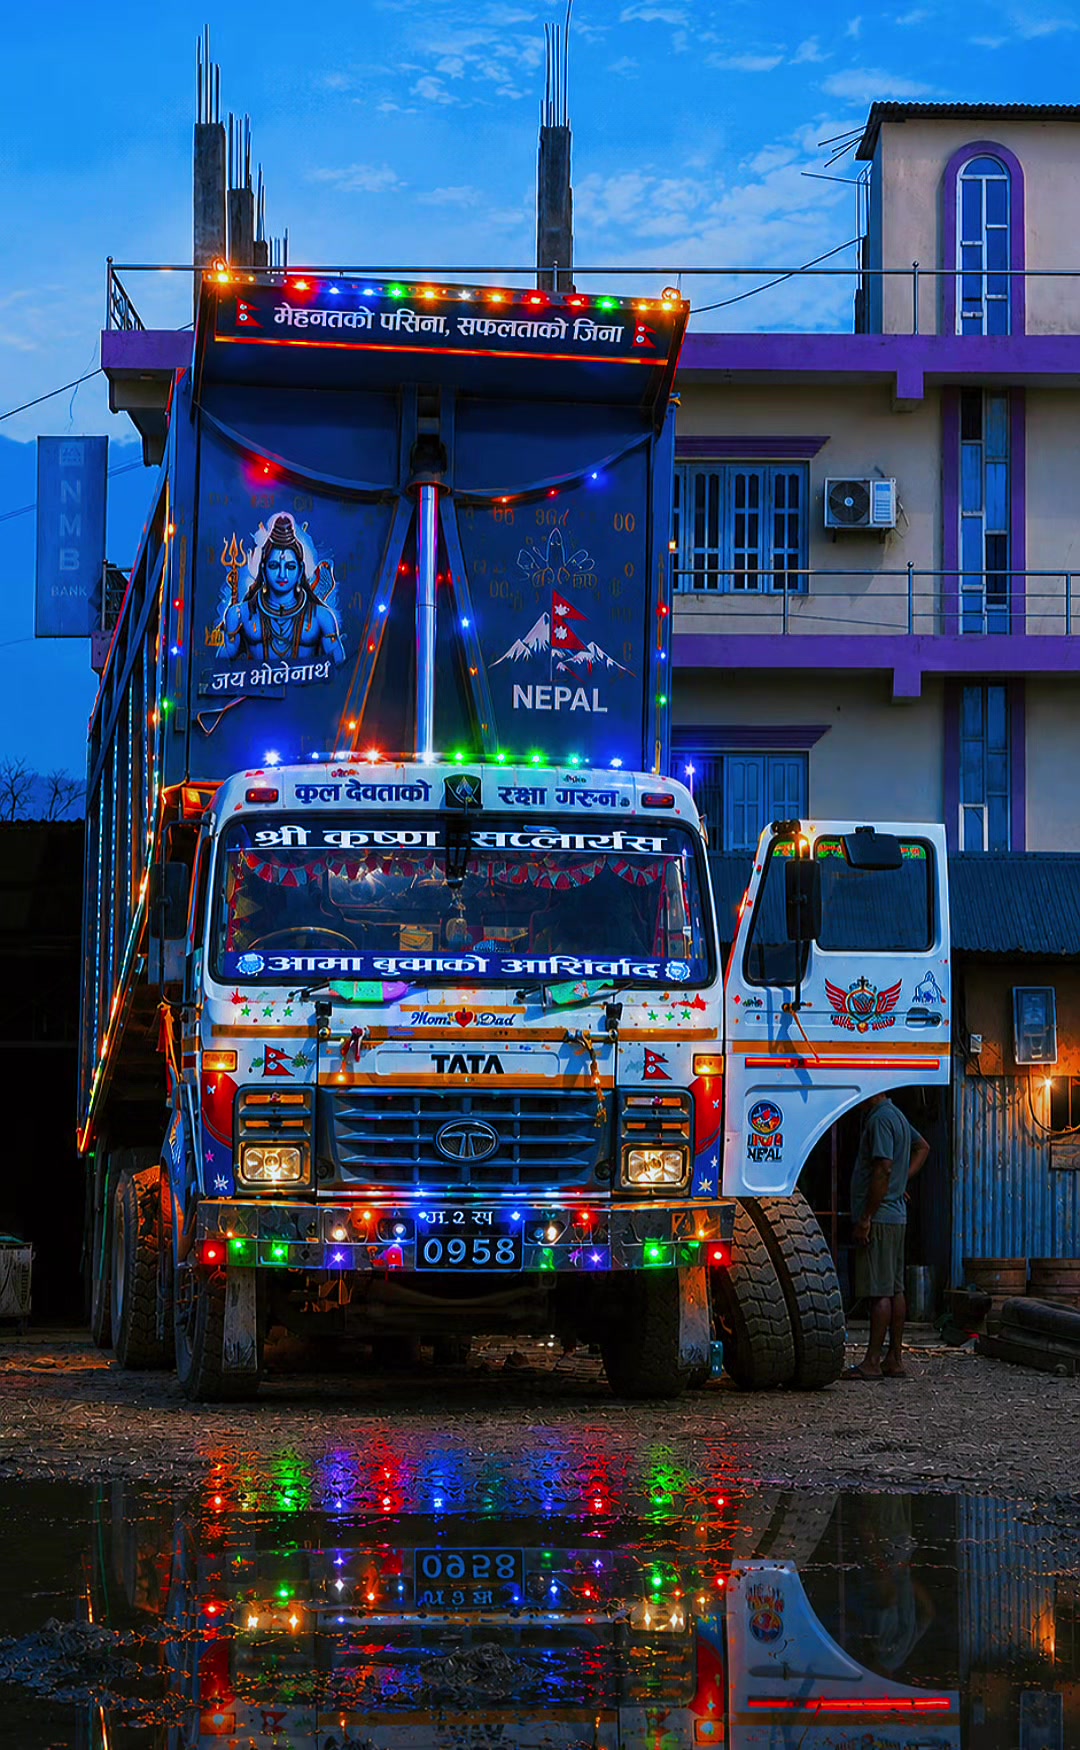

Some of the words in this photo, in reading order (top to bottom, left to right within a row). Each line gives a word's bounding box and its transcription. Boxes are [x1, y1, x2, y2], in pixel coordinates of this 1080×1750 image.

[274, 302, 375, 329] मेहनतको
[380, 309, 450, 337] पसिना,
[456, 317, 569, 340] सफलताको
[573, 317, 625, 343] जिना
[51, 585, 88, 597] BANK
[211, 671, 246, 691] जय
[250, 660, 331, 686] भोलेनाथ
[512, 683, 608, 714] NEPAL
[295, 783, 342, 804] कुल
[345, 778, 432, 803] देवताको
[498, 786, 548, 806] रक्षा
[254, 825, 311, 848] श्री
[322, 829, 441, 849] कृष्ण
[268, 956, 364, 972] आमा
[478, 1012, 517, 1027] Dad
[431, 1053, 505, 1075] TATA
[423, 1237, 516, 1266] 0958
